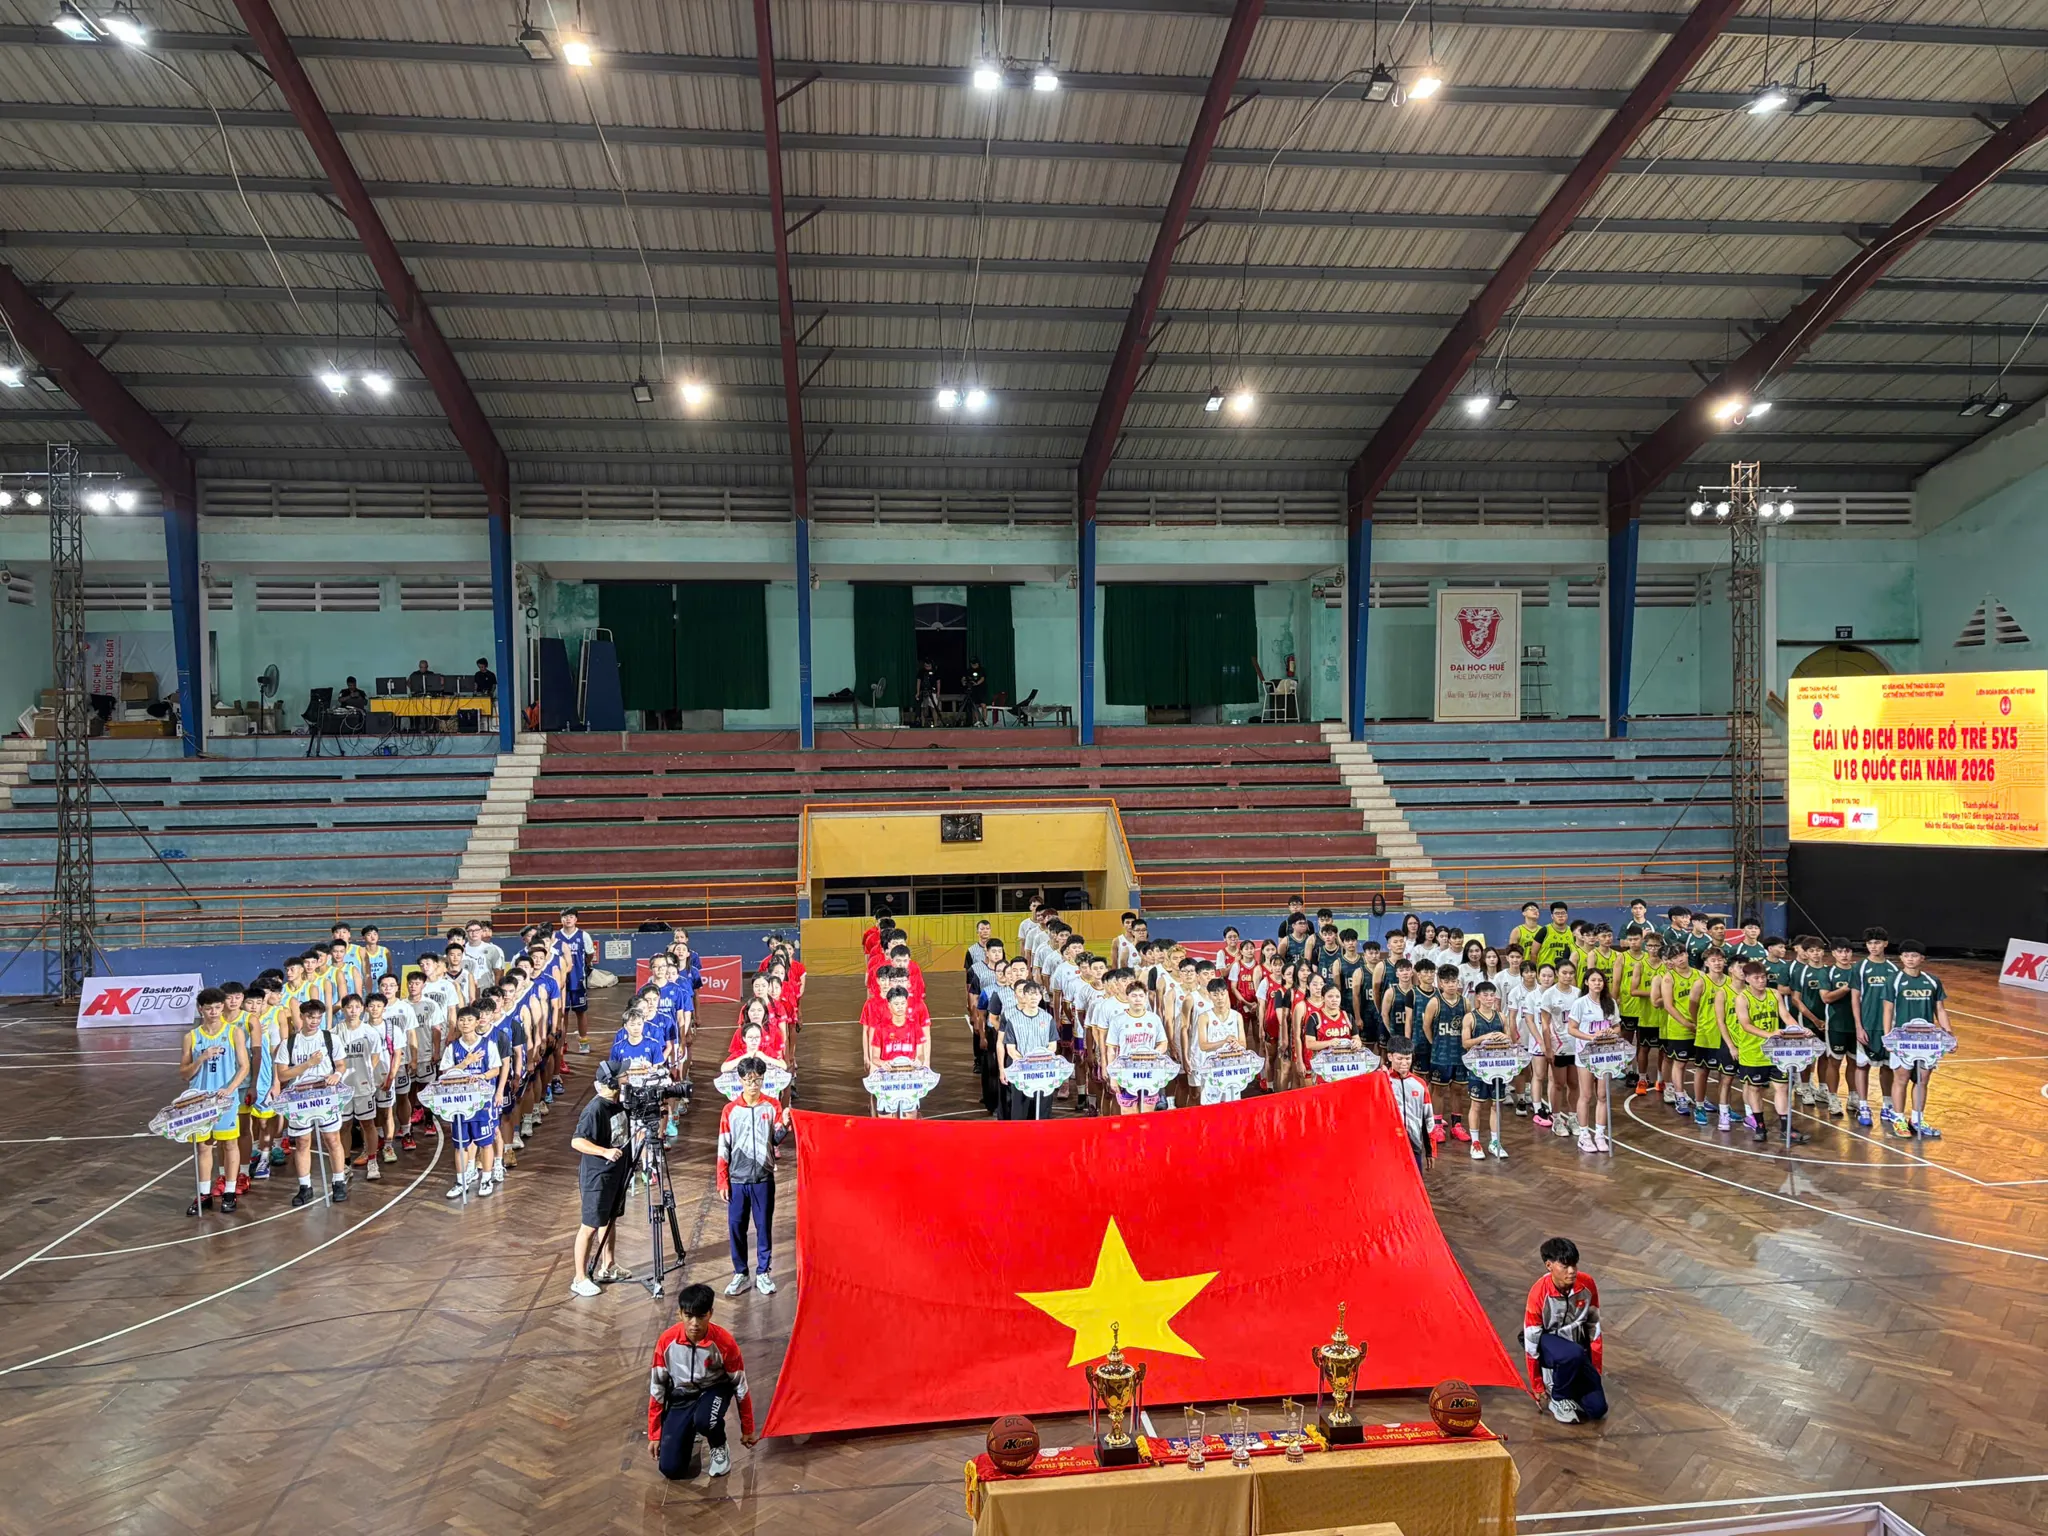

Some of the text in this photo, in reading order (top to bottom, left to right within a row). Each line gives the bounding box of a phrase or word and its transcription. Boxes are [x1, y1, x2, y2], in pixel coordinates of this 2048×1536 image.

[1450, 661, 1506, 673] ĐẠI HỌC HUẾ
[1813, 720, 2018, 754] GIẢI VÔ ĐỊCH BÓNG RỔ TRẺ 5X5
[1834, 753, 1995, 783] U18 QUỐC GIA NĂM 2026
[2004, 952, 2047, 980] AK
[701, 978, 729, 991] Play
[82, 986, 194, 1016] AK Basketball pro
[1439, 1023, 1452, 1036] 54
[1762, 1021, 1772, 1030] 31
[1133, 1071, 1152, 1079] HUẾ
[310, 1099, 323, 1109] NỘI
[454, 1094, 467, 1103] NỘI
[1449, 1398, 1465, 1409] AK
[1004, 1418, 1024, 1428] BTC
[1002, 1438, 1018, 1449] AK
